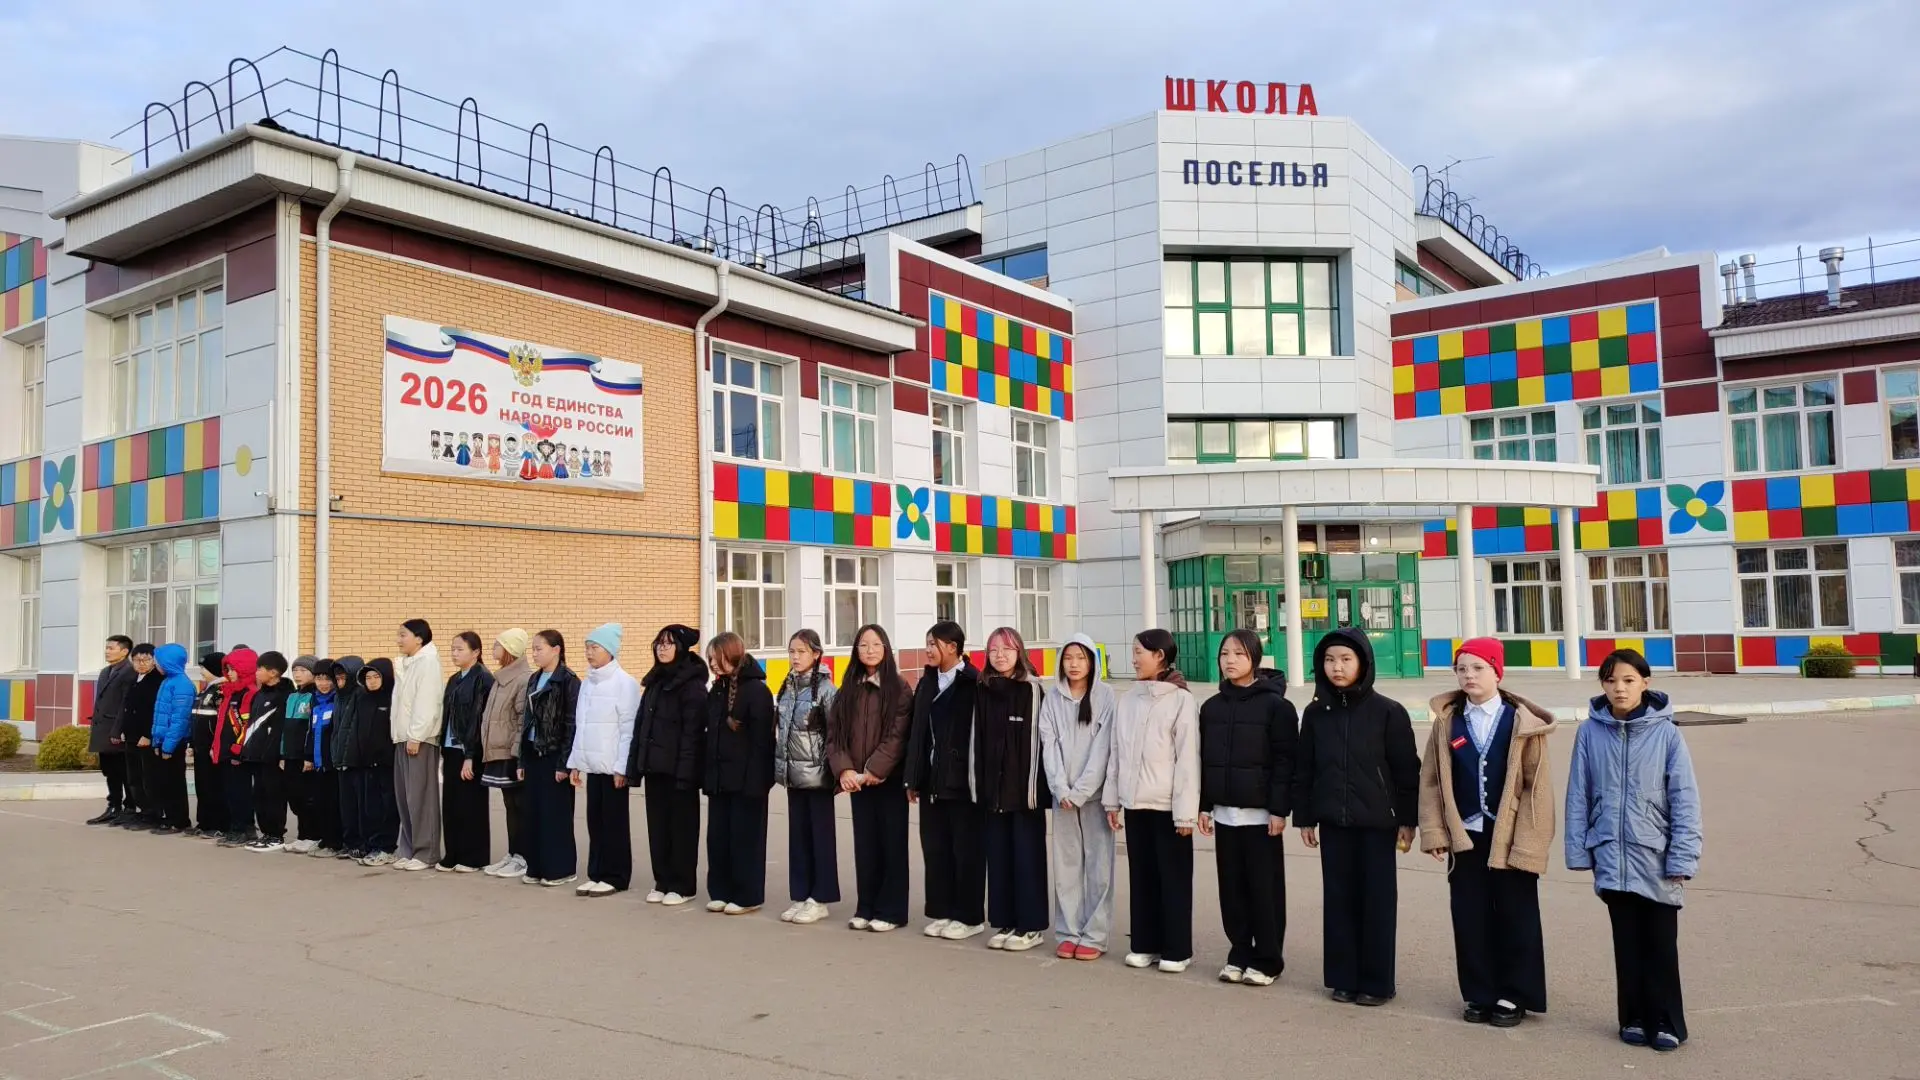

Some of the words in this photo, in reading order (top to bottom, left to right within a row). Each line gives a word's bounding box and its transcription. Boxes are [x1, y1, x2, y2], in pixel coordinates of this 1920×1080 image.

[1165, 77, 1318, 116] ШКОЛА
[1183, 159, 1328, 188] ПОСЕЛЬЯ
[400, 372, 488, 415] 2026
[511, 390, 543, 409] ГОД
[546, 396, 623, 419] ЕДИНСТВА
[499, 407, 573, 432] НАРОДОВ
[577, 419, 634, 438] РОССИИ
